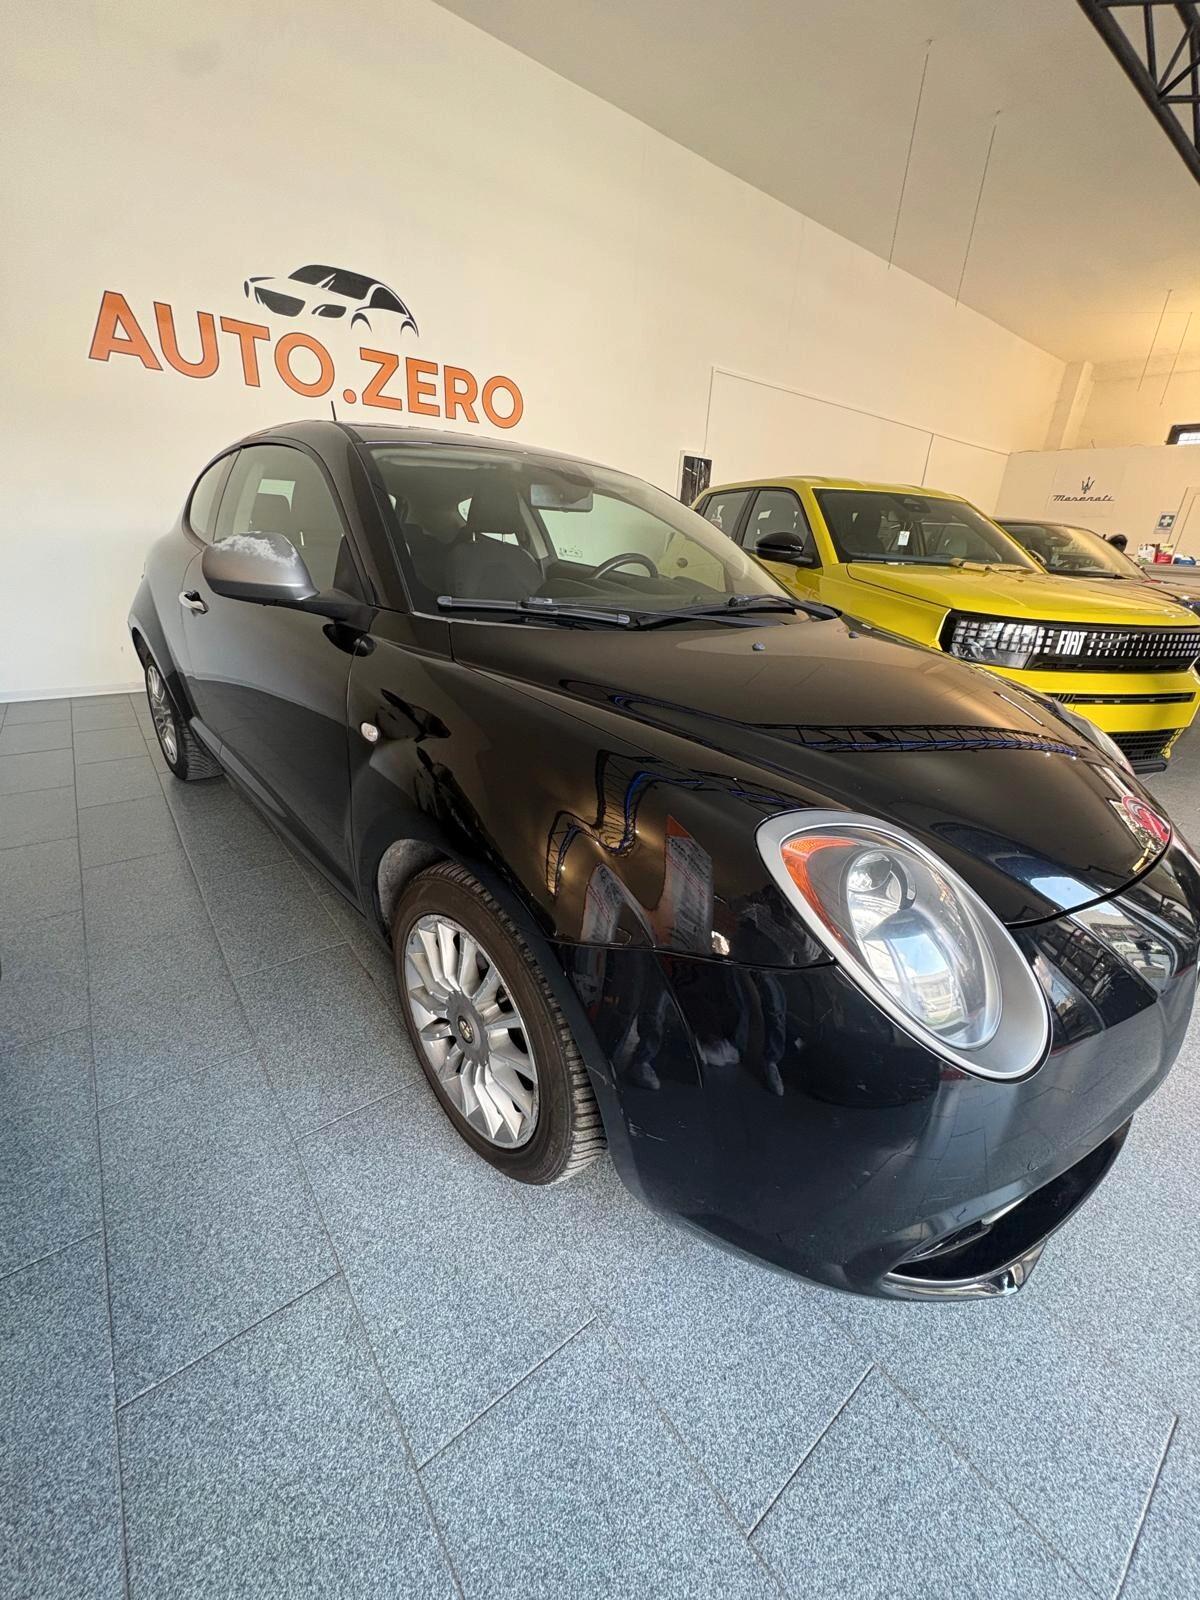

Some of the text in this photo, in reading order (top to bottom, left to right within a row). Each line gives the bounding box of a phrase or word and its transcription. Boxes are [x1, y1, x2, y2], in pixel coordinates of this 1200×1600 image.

[88, 290, 524, 429] AUTO.ZERO
[1053, 494, 1114, 502] Maserati
[1055, 630, 1088, 655] FIAT
